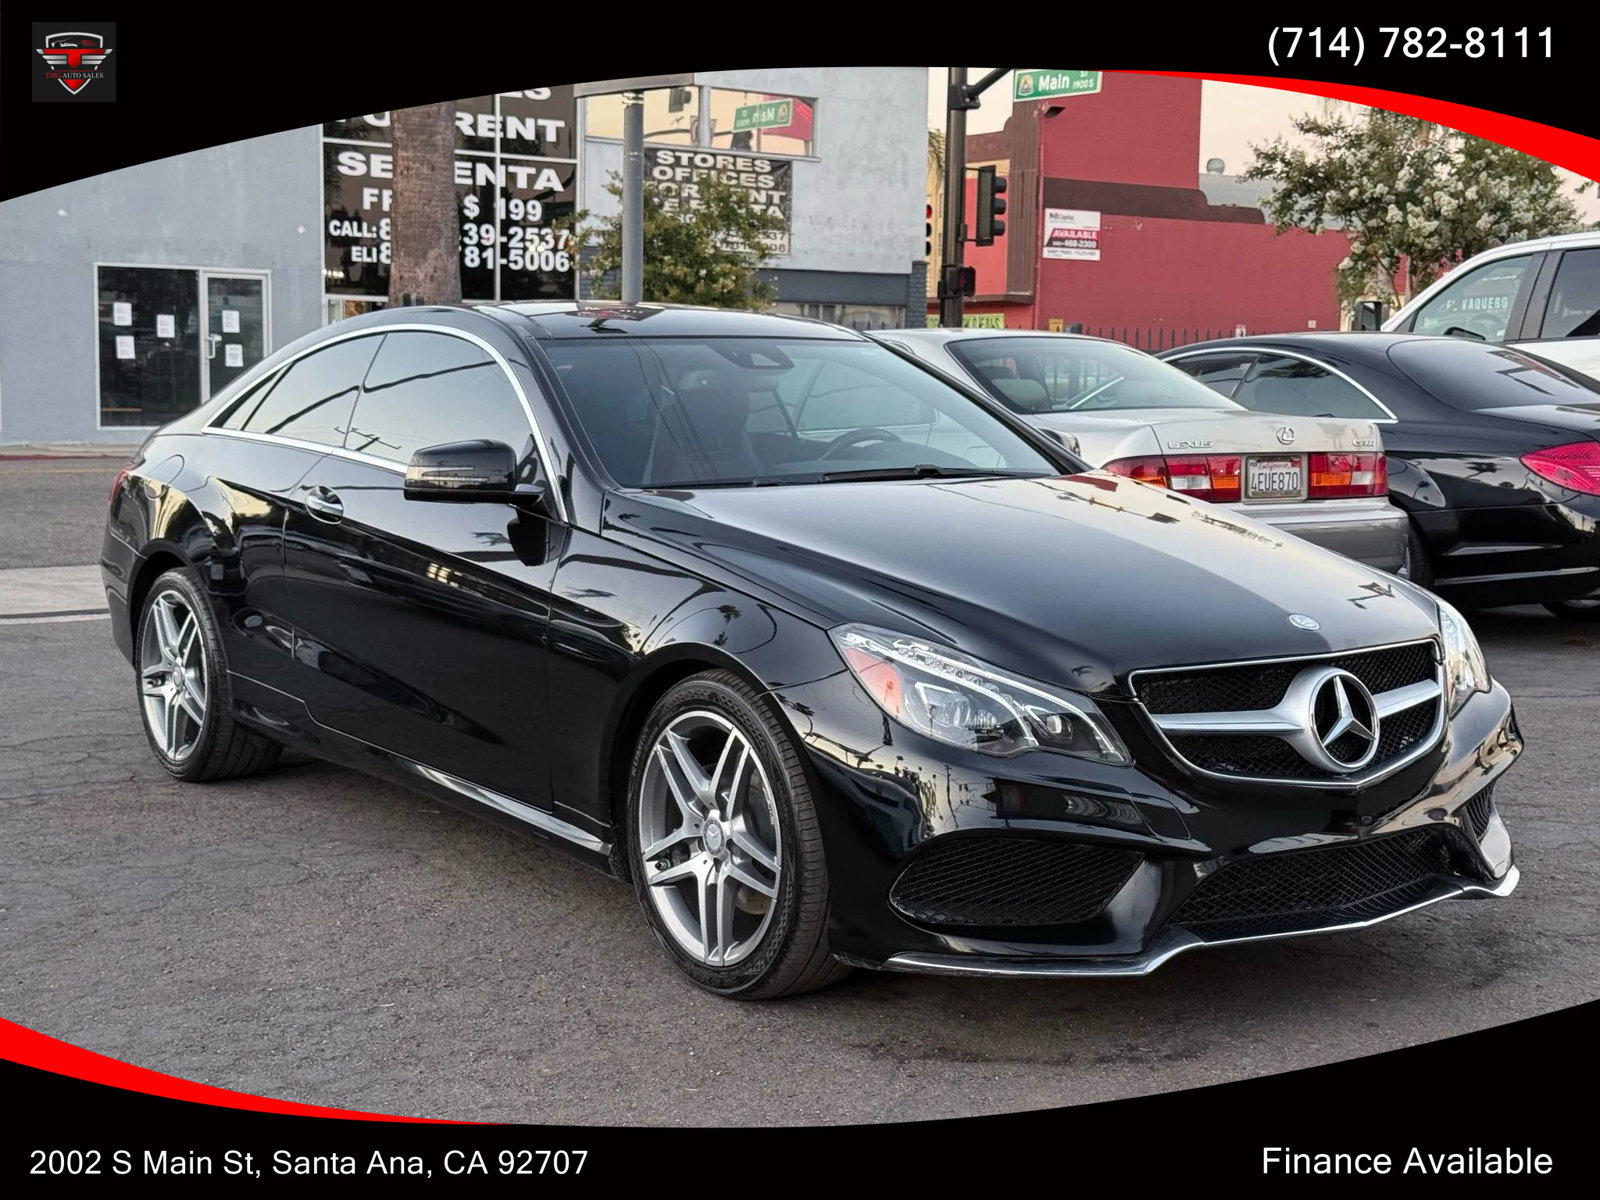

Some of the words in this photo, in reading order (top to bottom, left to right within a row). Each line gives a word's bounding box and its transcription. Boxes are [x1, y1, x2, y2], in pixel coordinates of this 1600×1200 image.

[1038, 72, 1071, 92] Main
[455, 111, 565, 142] RENT
[656, 150, 772, 173] STORES
[454, 161, 565, 192] ENTA
[652, 165, 775, 189] OFFICES
[463, 193, 480, 220] $
[328, 219, 378, 239] CALL:
[1053, 229, 1098, 240] AVAILABLE
[463, 246, 570, 273] 81-5006
[1168, 440, 1214, 449] LEXUS
[1251, 471, 1299, 492] 4EUE870
